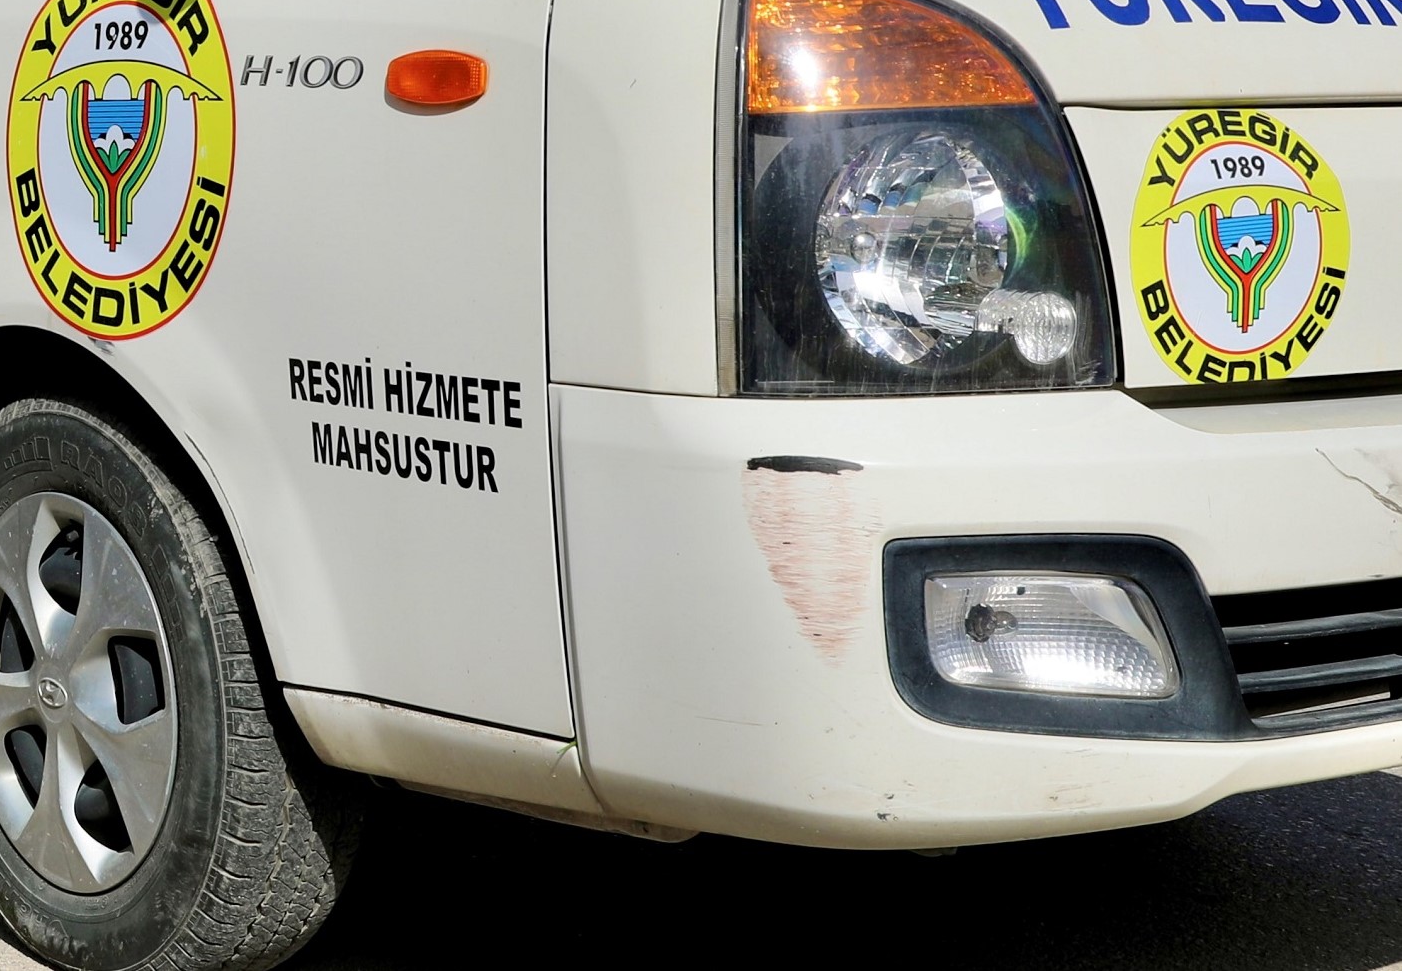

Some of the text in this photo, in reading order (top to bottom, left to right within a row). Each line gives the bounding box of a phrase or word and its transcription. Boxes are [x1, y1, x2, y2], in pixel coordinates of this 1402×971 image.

[95, 21, 148, 51] 1989
[240, 55, 364, 90] H-100
[1147, 109, 1319, 190] YÜREĞİR
[1210, 154, 1266, 180] 1989
[15, 168, 226, 328] BELEDİYESİ
[1141, 267, 1346, 383] BELEDİYESİ
[288, 357, 523, 429] RESMİ HİZMETE
[311, 421, 499, 493] MAHSUSTUR
